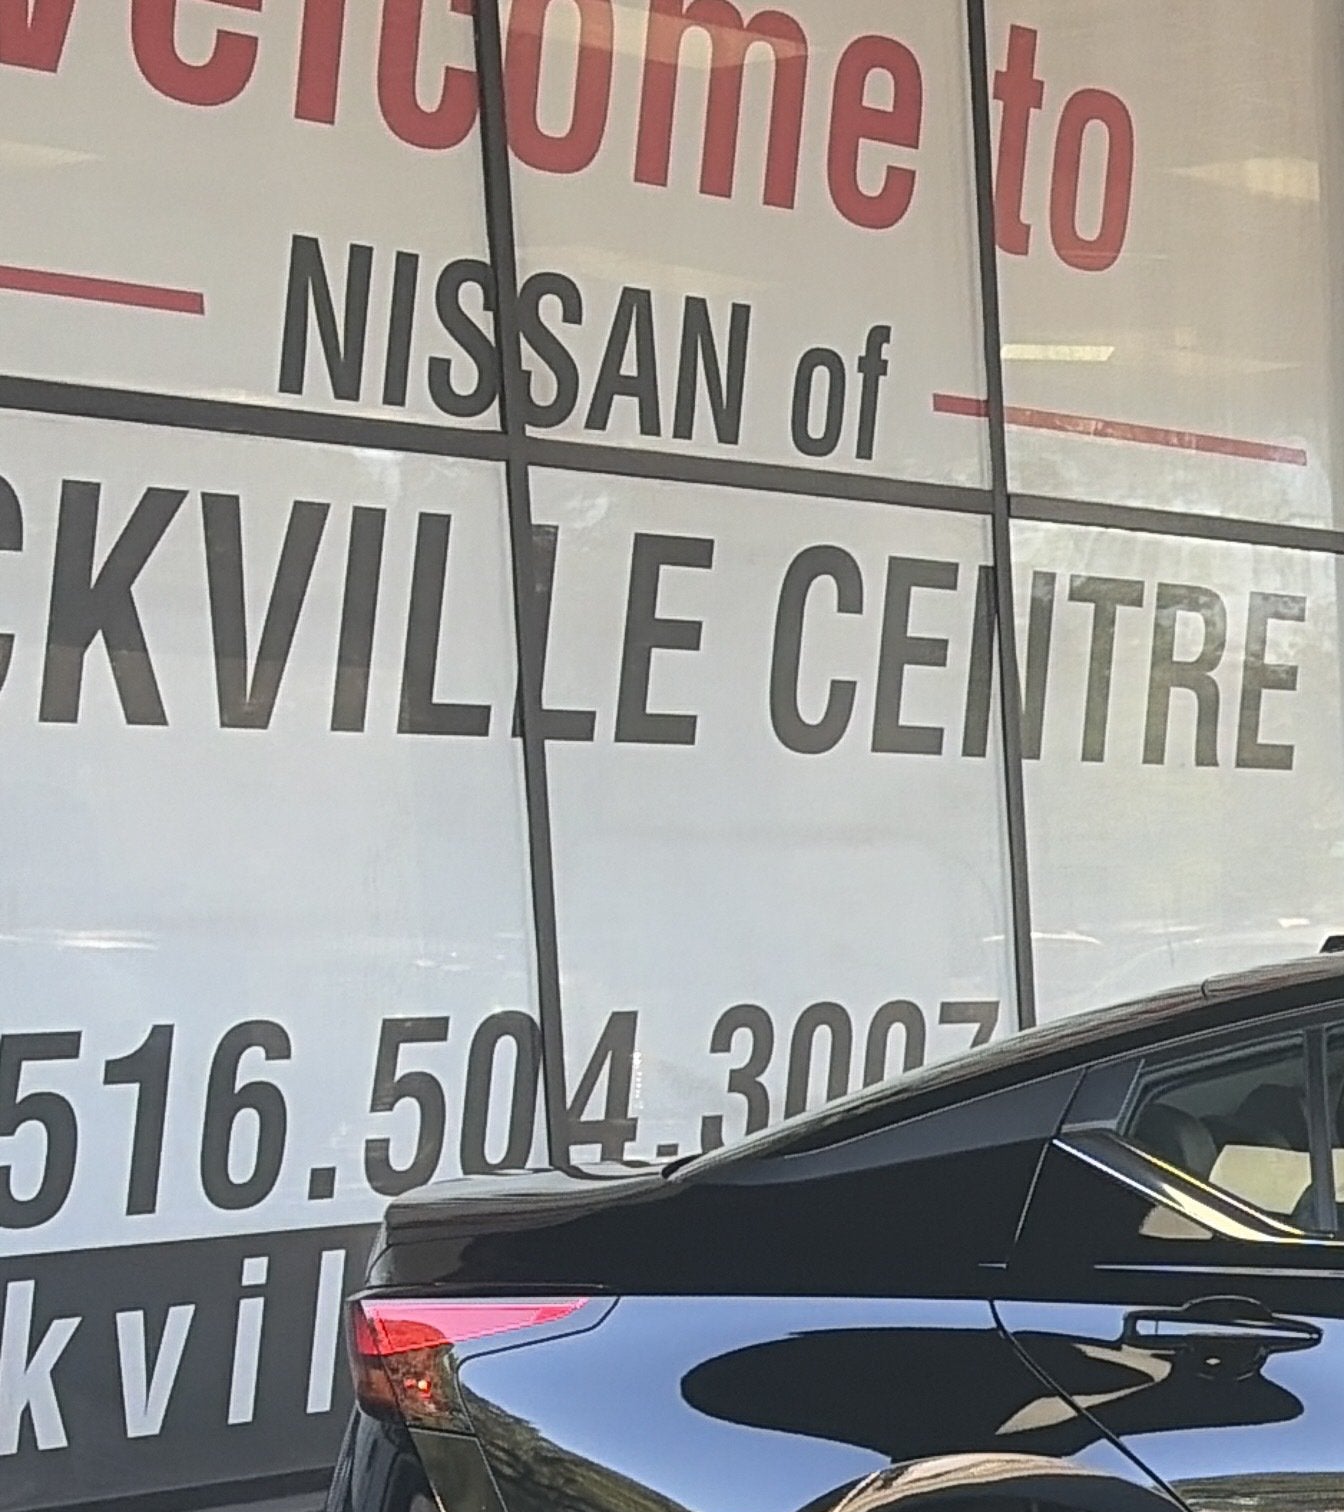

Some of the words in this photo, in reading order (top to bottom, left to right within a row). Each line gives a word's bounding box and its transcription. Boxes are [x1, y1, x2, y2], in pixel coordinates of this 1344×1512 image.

[0, 0, 922, 229] ecome
[993, 24, 1134, 271] to
[278, 234, 751, 445] NISSAN
[790, 325, 891, 460] of
[0, 474, 715, 745] KVILLE
[769, 544, 1307, 771] CENTRE
